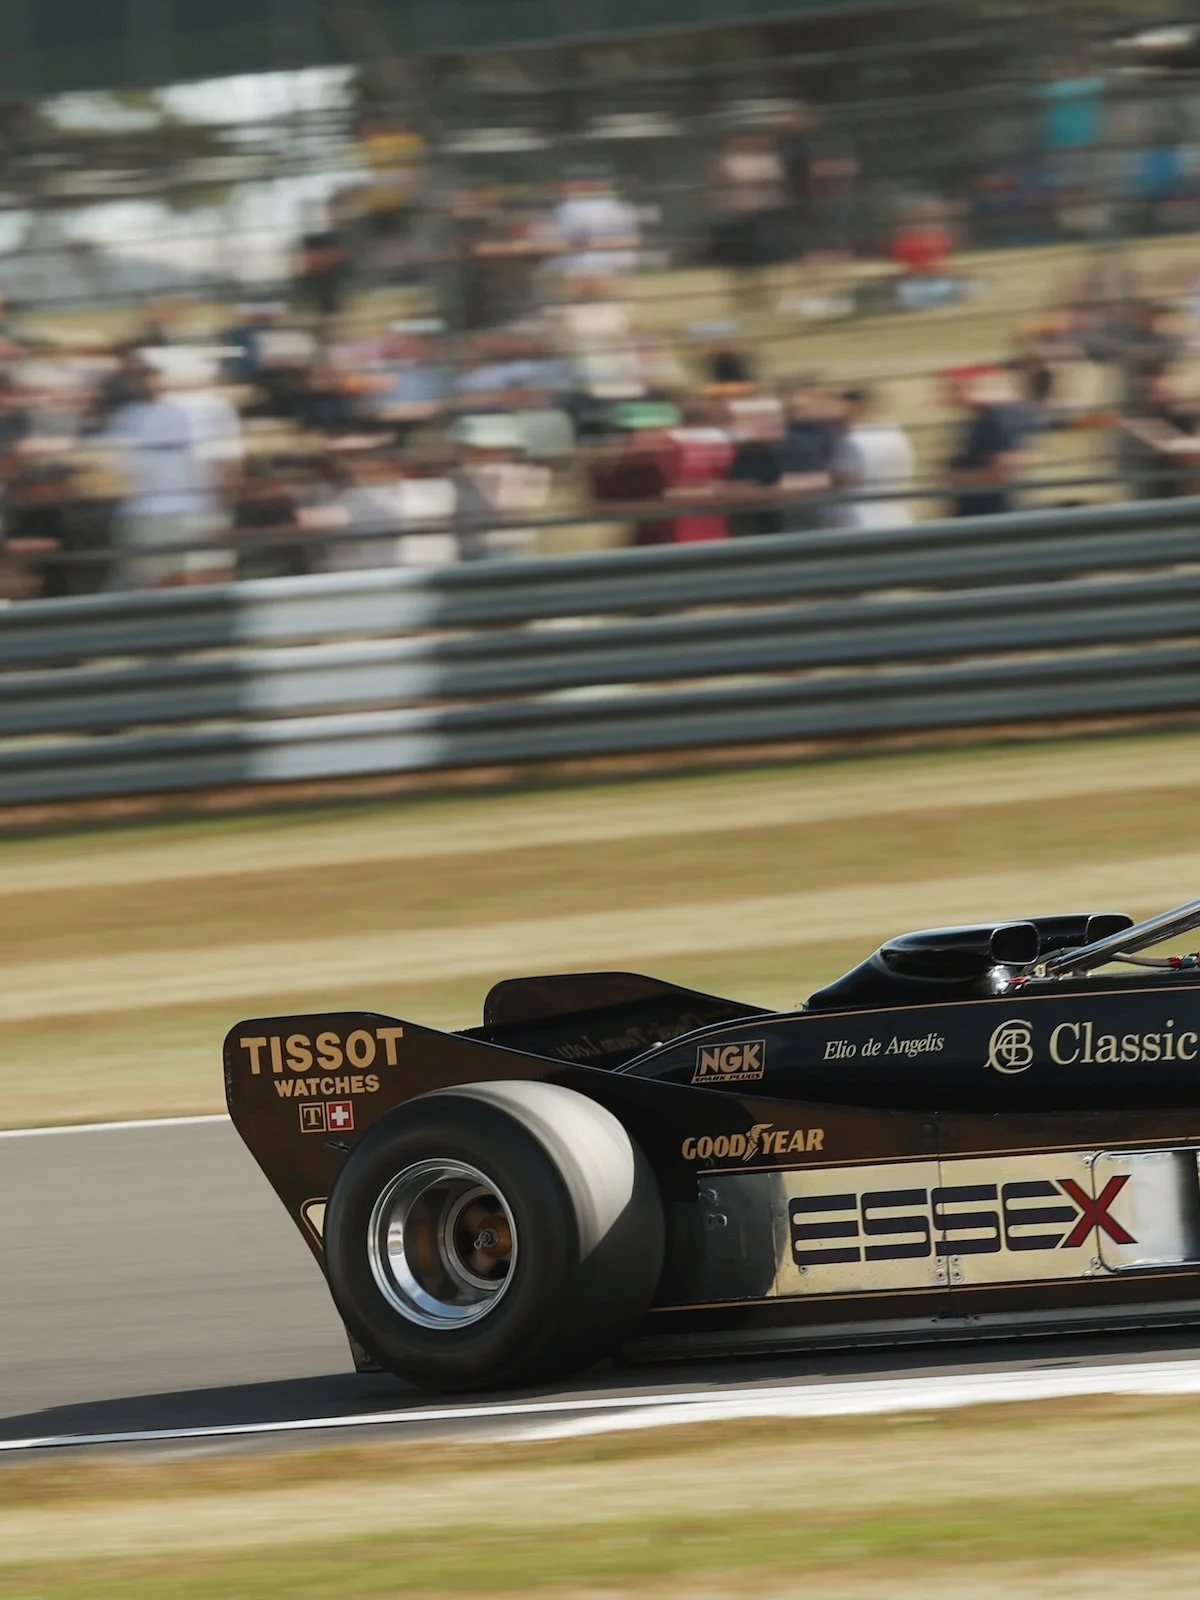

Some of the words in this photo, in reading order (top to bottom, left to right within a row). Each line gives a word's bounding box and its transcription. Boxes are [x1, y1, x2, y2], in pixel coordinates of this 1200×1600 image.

[240, 1027, 404, 1075] TISSOT
[699, 1043, 762, 1074] NGK
[823, 1041, 858, 1061] Elio
[861, 1038, 882, 1058] de
[884, 1032, 945, 1059] Angelis
[1049, 1020, 1198, 1066] Classic
[273, 1074, 380, 1098] WATCHES
[694, 1075, 726, 1083] SPARK
[729, 1073, 761, 1081] PLUGS
[303, 1106, 321, 1126] T
[681, 1124, 825, 1161] GOODYEAR
[788, 1173, 1140, 1267] ESSEX
